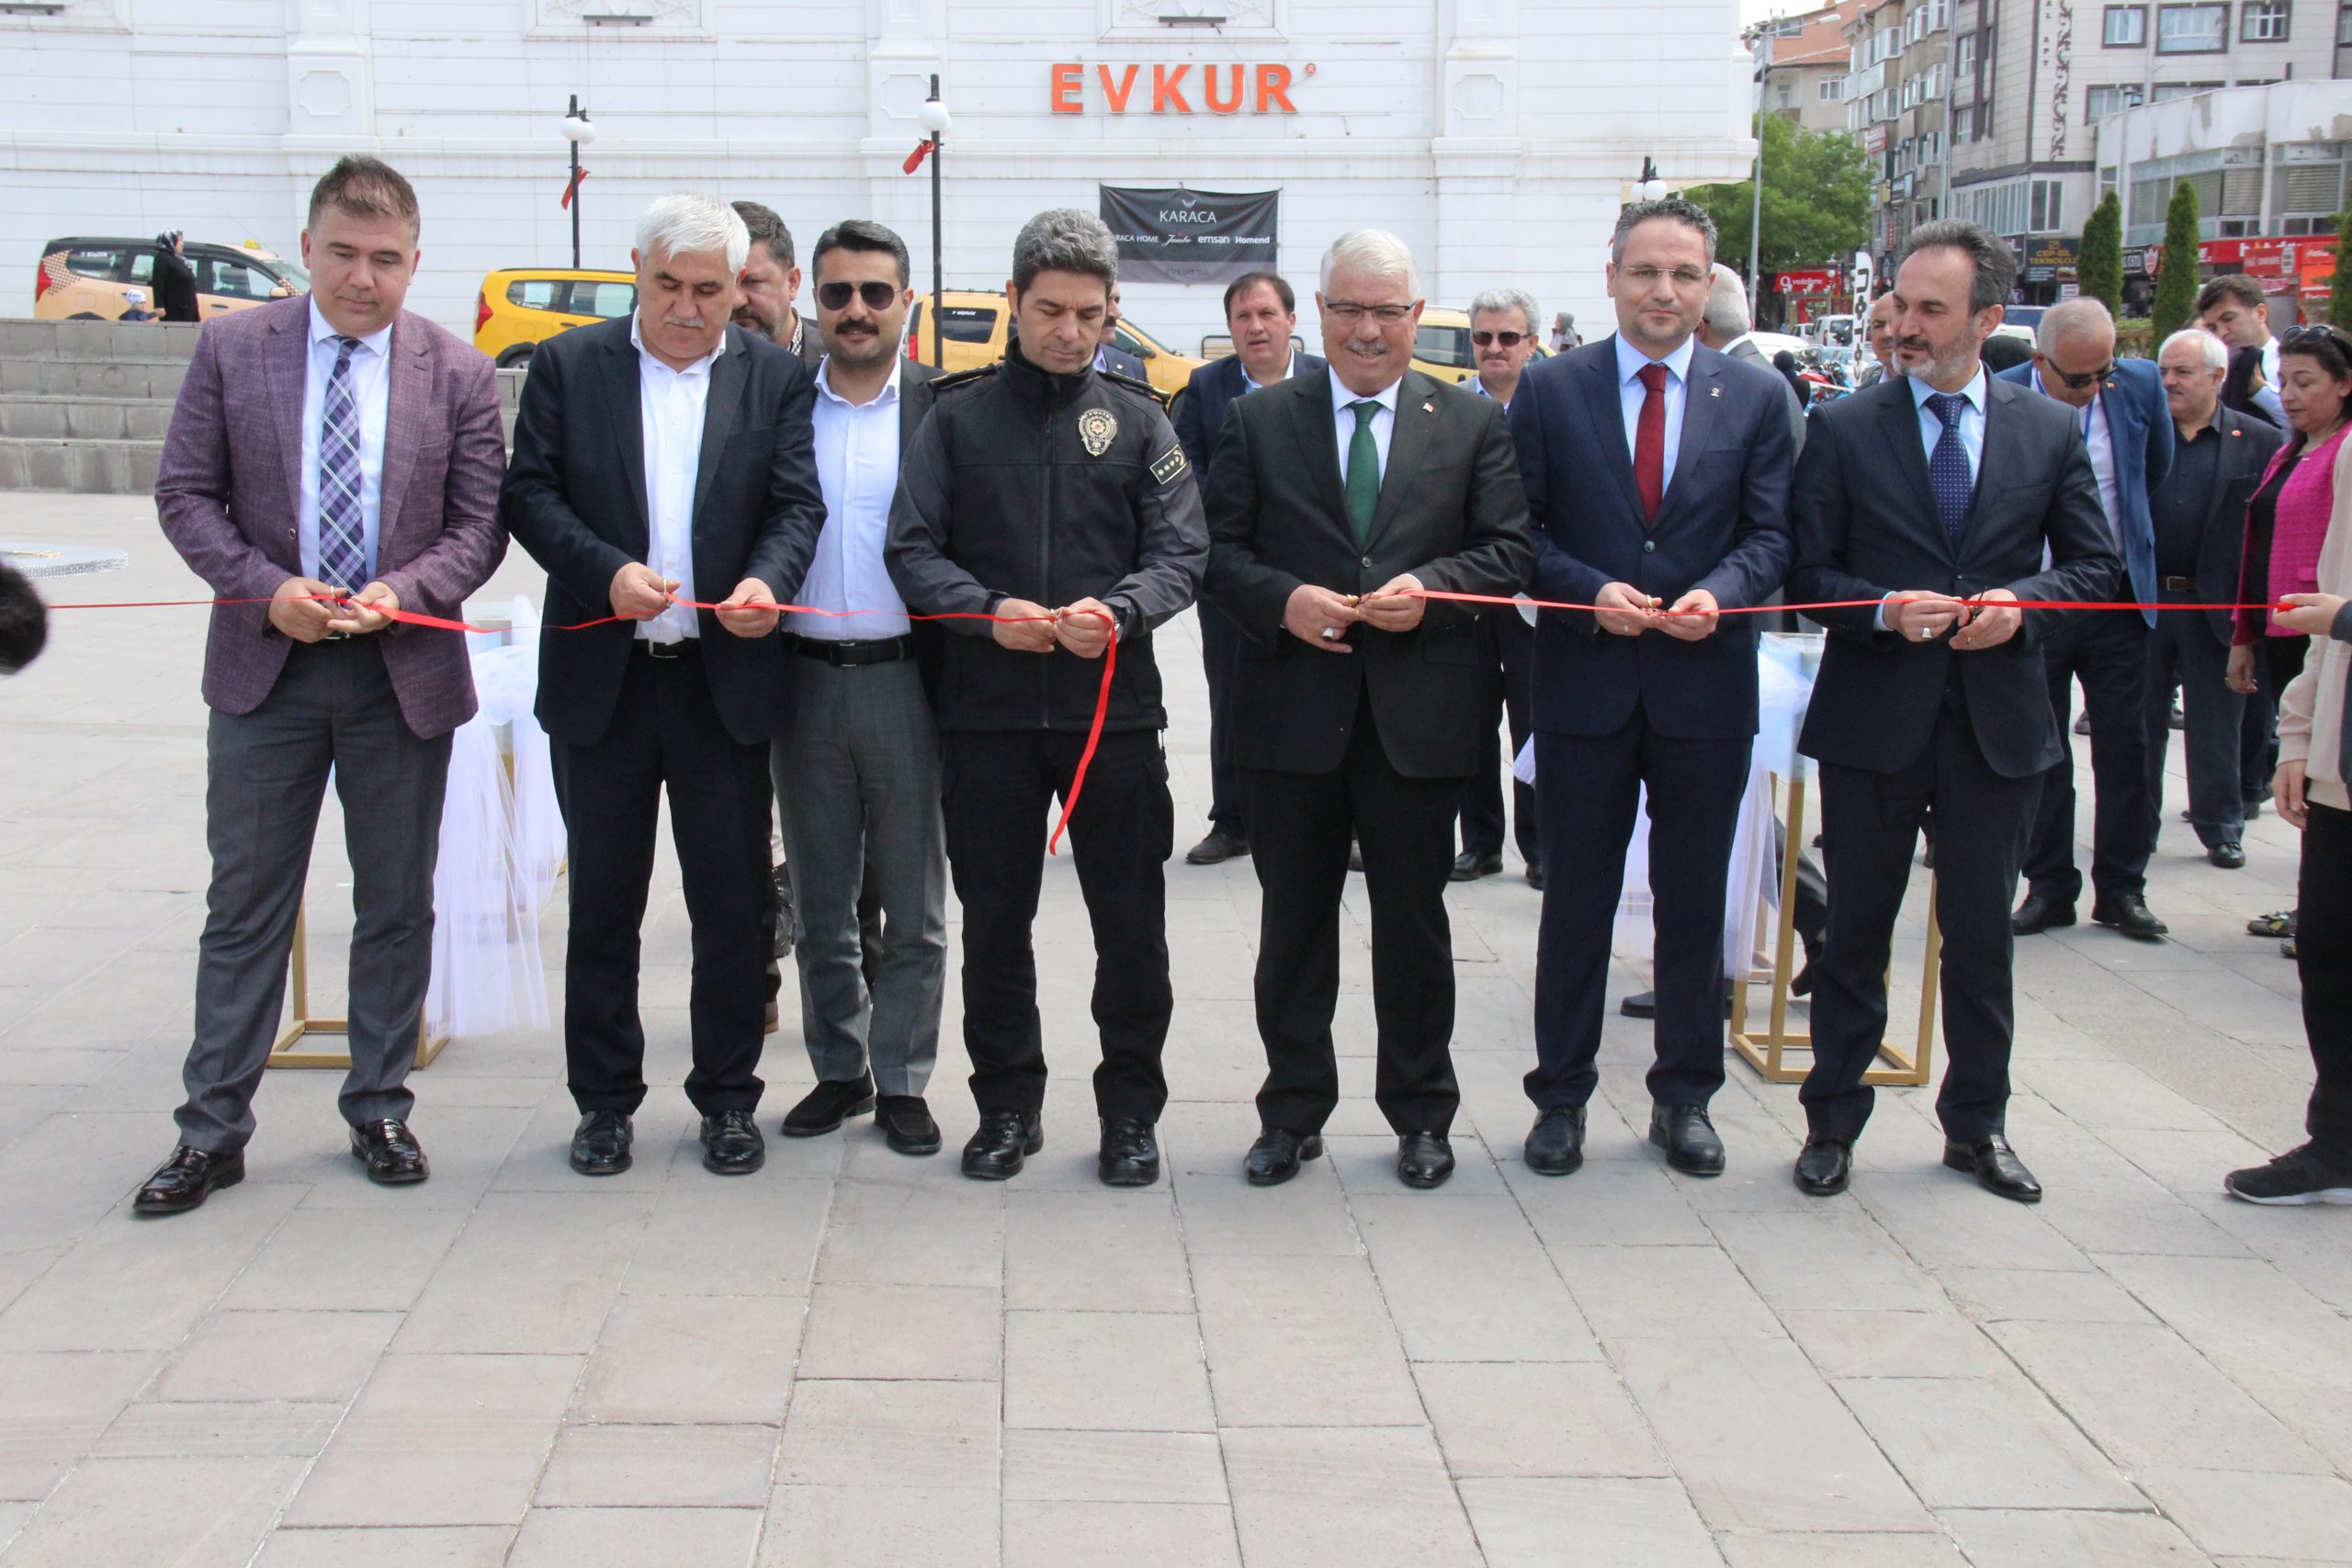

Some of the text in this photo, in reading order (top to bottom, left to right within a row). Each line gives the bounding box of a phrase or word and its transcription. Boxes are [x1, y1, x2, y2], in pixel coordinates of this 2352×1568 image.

[1051, 63, 1297, 115] EVKUR
[1159, 210, 1216, 223] KARACA
[1112, 234, 1135, 243] ARACA
[1197, 235, 1230, 244] emsan
[1235, 236, 1271, 244] Homend
